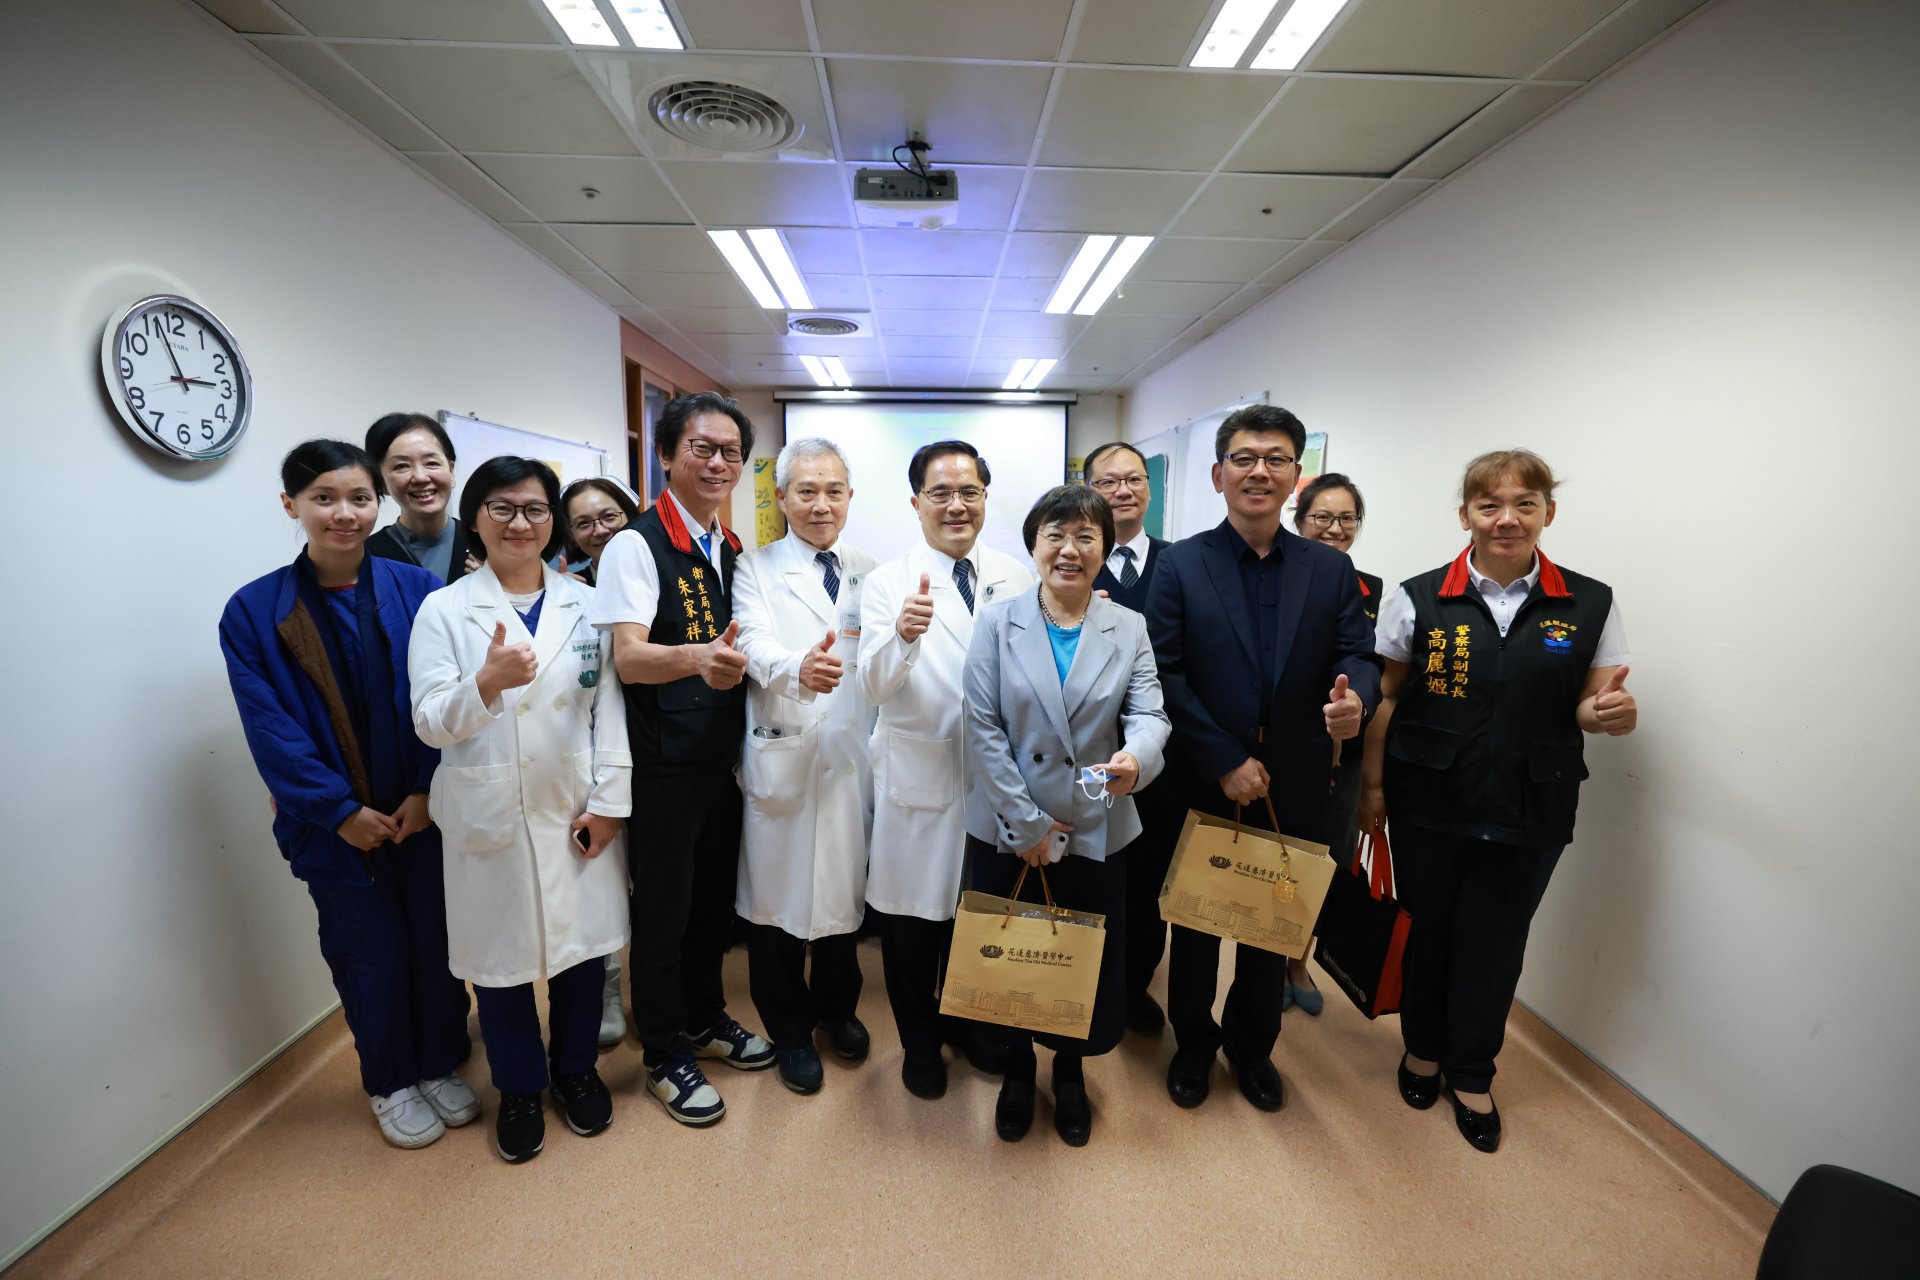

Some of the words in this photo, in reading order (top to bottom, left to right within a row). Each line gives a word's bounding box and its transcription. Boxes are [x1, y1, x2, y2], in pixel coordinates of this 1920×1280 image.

[164, 311, 186, 337] 12
[125, 330, 149, 356] 10
[199, 328, 205, 350] 1
[121, 356, 134, 380] 9
[212, 353, 226, 375] 2
[129, 386, 146, 410] 8
[220, 379, 232, 400] 3
[149, 410, 165, 433] 7
[214, 403, 228, 423] 4
[176, 423, 191, 445] 6
[201, 418, 214, 440] 5
[677, 576, 703, 641] 朱家祥
[1450, 624, 1472, 698] 警察局副局長
